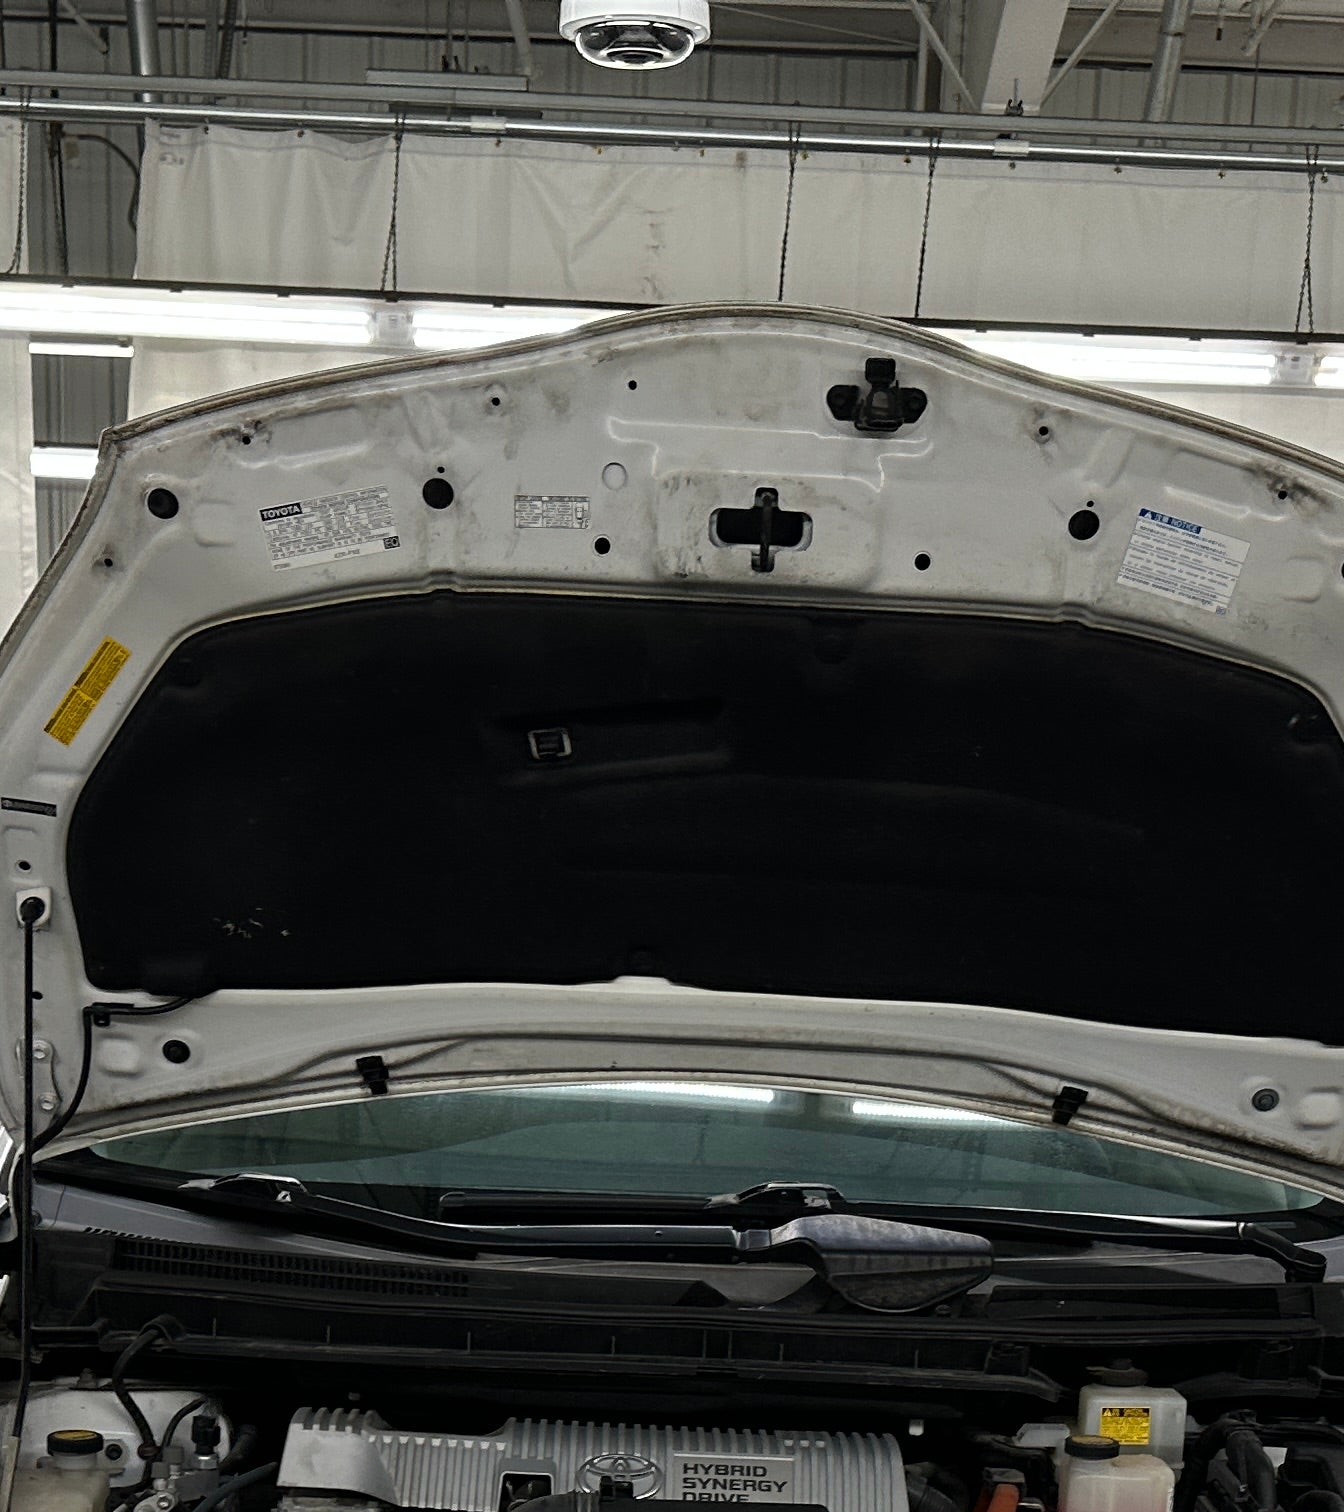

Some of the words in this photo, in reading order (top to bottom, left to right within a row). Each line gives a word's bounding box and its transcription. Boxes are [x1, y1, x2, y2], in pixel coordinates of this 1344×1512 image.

[261, 505, 300, 519] TOYOTA
[683, 1463, 767, 1477] HYBRID
[682, 1478, 788, 1492] SYNERGY
